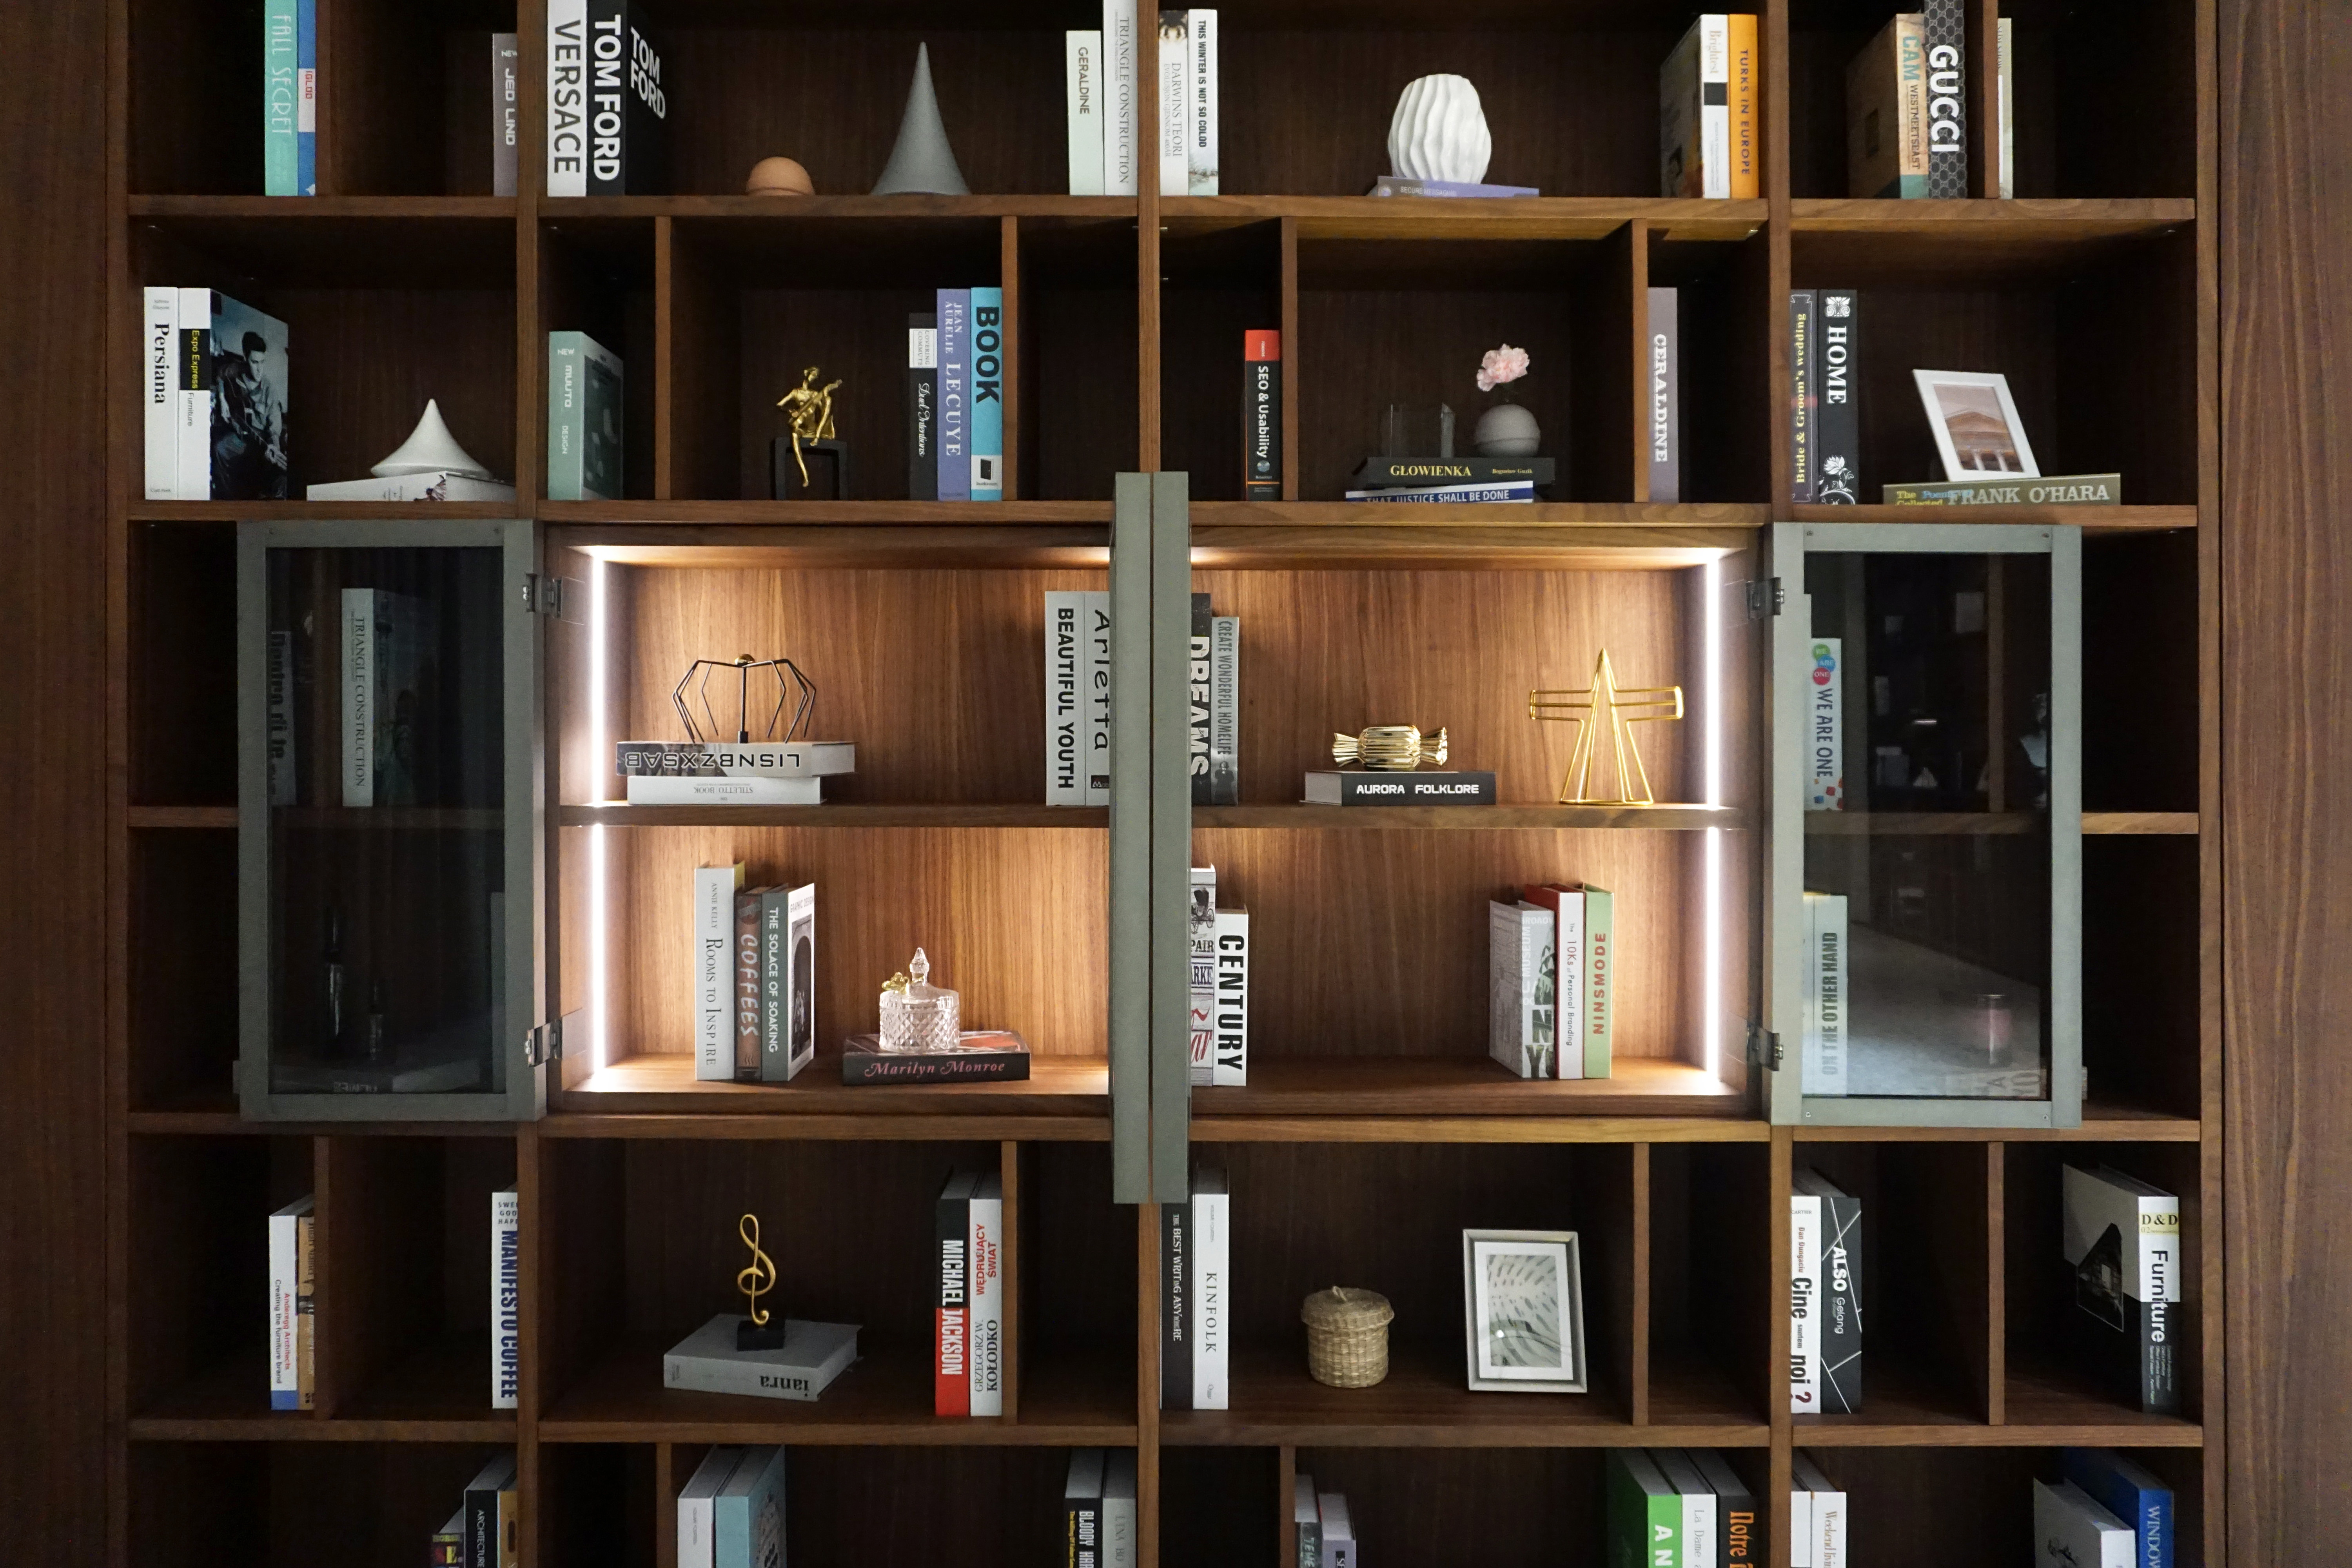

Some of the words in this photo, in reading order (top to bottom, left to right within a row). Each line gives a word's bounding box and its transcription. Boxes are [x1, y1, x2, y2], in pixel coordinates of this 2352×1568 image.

[272, 15, 292, 55] FALL
[594, 14, 621, 87] TOM
[1119, 17, 1129, 81] TRIANGLE
[1198, 20, 1206, 39] THIS
[630, 25, 661, 85] TOM
[1198, 41, 1206, 74] WINTER
[1740, 49, 1749, 92] TURKS
[1902, 35, 1920, 81] CAM
[272, 67, 292, 136] SECRET
[554, 20, 581, 173] VERSACE
[630, 59, 666, 119] FORD
[1078, 47, 1090, 114] GERALDINE
[1172, 62, 1182, 118] DARWINS
[1198, 87, 1207, 103] NOT
[1929, 45, 1959, 152] GUCCI
[505, 108, 515, 145] LIND
[1198, 106, 1207, 118] SO
[1741, 100, 1749, 114] IN
[594, 94, 621, 181] FORD
[1119, 84, 1129, 184] CONSTRUCTION
[1172, 122, 1182, 157] TEORI
[1741, 122, 1750, 175] EUROPE
[945, 301, 953, 354] AURELIE
[953, 303, 962, 333] JEAN
[1795, 313, 1806, 363] wedding
[192, 330, 200, 352] Expo
[976, 306, 1000, 404] BOOK
[154, 323, 170, 404] Persiana
[191, 355, 200, 389] Express
[1258, 366, 1269, 390] SEO
[1827, 325, 1847, 404] HOME
[187, 392, 195, 426] Furniture
[946, 363, 961, 456] LECUYE
[1258, 392, 1269, 402] &
[1256, 405, 1270, 458] Usability
[1796, 432, 1805, 443] &
[1390, 465, 1472, 477] GŁOWIENKA
[1796, 446, 1805, 483] Bride
[1437, 492, 1468, 503] SHALL
[1469, 492, 1481, 501] BE
[1483, 490, 1509, 500] DONE
[1896, 490, 1916, 499] The
[1948, 487, 2021, 505] FRANK
[2029, 485, 2110, 503] O'HARA
[355, 616, 365, 682] TRIANGLE
[1218, 620, 1232, 652] CREATE
[1058, 608, 1074, 716] BEAUTIFUL
[1218, 655, 1232, 709] WONDERFUL
[1191, 637, 1210, 777] DREAMS
[1817, 688, 1833, 710] WE
[355, 684, 365, 787] CONSTRUCTION
[1217, 712, 1232, 755] HOMELIFE
[1817, 715, 1833, 742] ARE
[1058, 722, 1074, 788] YOUTH
[1817, 747, 1833, 777] ONE
[1356, 784, 1405, 794] AURORA
[1415, 784, 1479, 794] FOLKLORE
[769, 907, 779, 929] THE
[769, 934, 778, 978] SOLACE
[1522, 926, 1531, 977] MUSEUM
[1822, 933, 1838, 973] HAND
[740, 934, 759, 1037] COFFEES
[769, 981, 778, 997] OF
[1218, 935, 1245, 1071] CENTURY
[1593, 933, 1606, 1034] NINSMODE
[1822, 976, 1838, 1022] OTHER
[768, 1000, 779, 1053] SOAKING
[1566, 1012, 1574, 1046] Branding
[1822, 1025, 1838, 1052] THE
[864, 1062, 935, 1078] Marilyn
[941, 1061, 1005, 1075] Monroe
[1822, 1056, 1838, 1075] ON
[1173, 1228, 1181, 1254] BEST
[2141, 1214, 2151, 1226] D
[2153, 1214, 2165, 1226] &
[2168, 1214, 2178, 1226] D
[942, 1240, 964, 1306] MICHAEL
[976, 1223, 985, 1296] WĘDRUJĄCY
[987, 1242, 996, 1278] ŚWIAT
[1832, 1247, 1847, 1292] ALSO
[1205, 1272, 1217, 1353] KINFOLK
[1834, 1297, 1846, 1334] Gelang
[2151, 1250, 2169, 1343] Furniture
[942, 1309, 963, 1375] JACKSON
[987, 1320, 998, 1392] KOŁODKO
[975, 1337, 984, 1392] GRZEGORZ
[1079, 1511, 1094, 1546] BLOODY
[1694, 1510, 1705, 1523] La
[1824, 1511, 1837, 1550] Weekend
[1694, 1530, 1704, 1557] Dame
